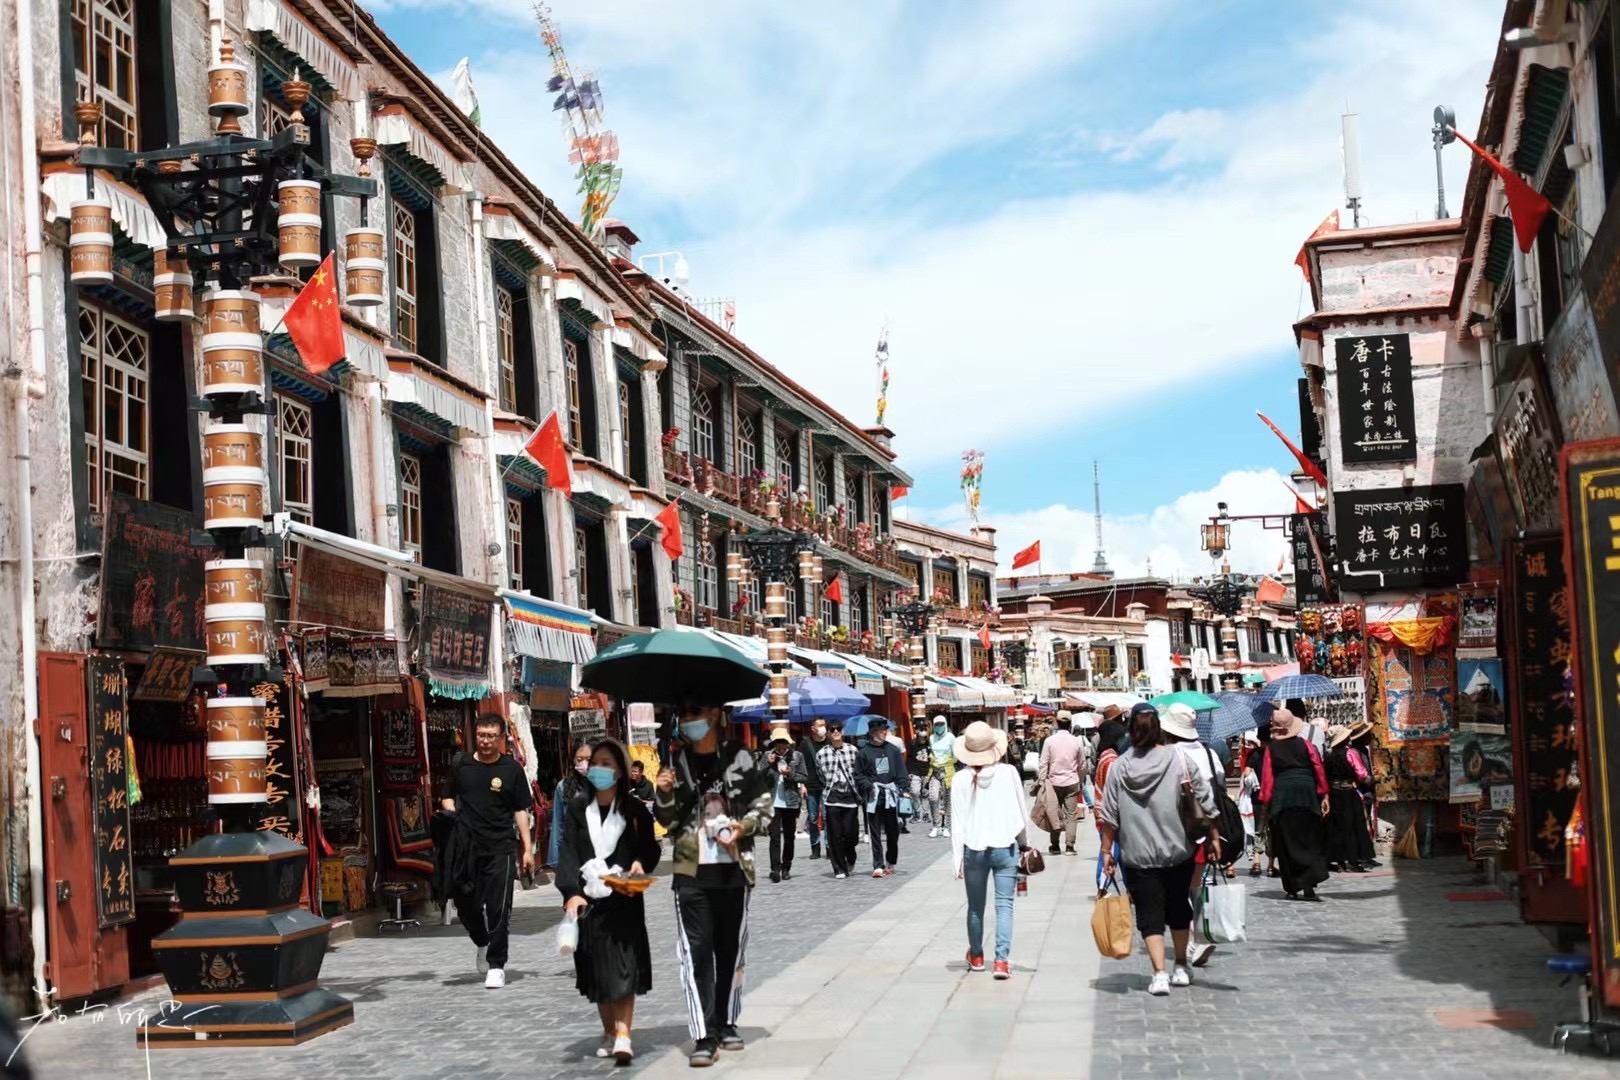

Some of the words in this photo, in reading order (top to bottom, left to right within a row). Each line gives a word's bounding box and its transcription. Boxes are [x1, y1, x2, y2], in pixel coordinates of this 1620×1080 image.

[1350, 339, 1394, 362] 唐卡
[1360, 368, 1374, 429] 百年世家
[1380, 364, 1397, 428] 古法绘制
[1358, 522, 1447, 544] 拉布日瓦
